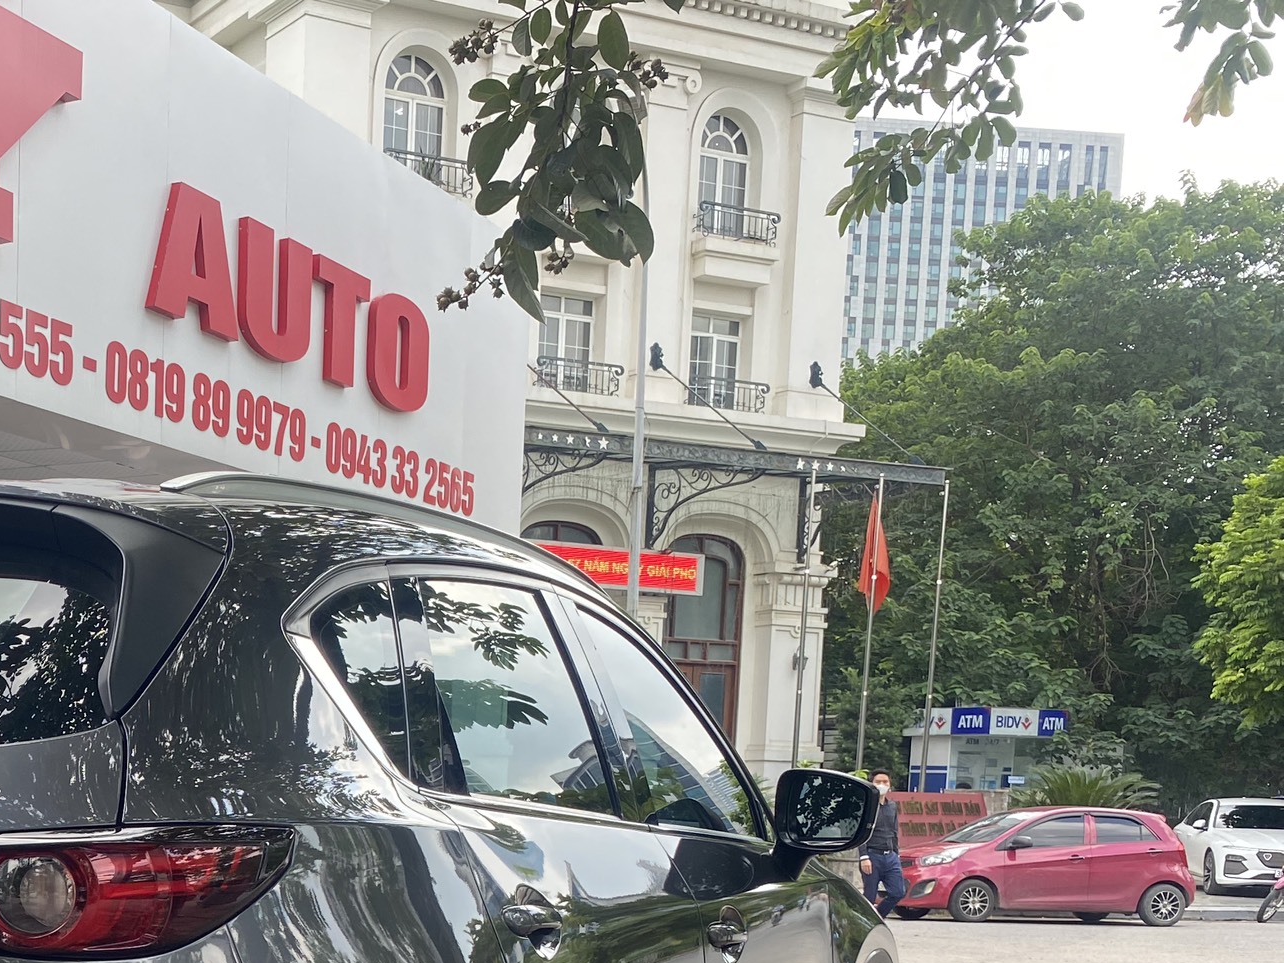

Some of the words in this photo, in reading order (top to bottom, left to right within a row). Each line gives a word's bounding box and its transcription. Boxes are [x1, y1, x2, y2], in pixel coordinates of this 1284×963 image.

[145, 181, 430, 413] AUTO
[105, 340, 185, 423] 0819
[192, 373, 229, 437] 89
[236, 388, 306, 462] 9979
[326, 422, 386, 489] 0943
[391, 446, 419, 499] 33
[423, 458, 475, 517] 2565
[957, 714, 983, 729] ATM
[996, 715, 1022, 729] BIDV
[1042, 716, 1065, 731] ATM
